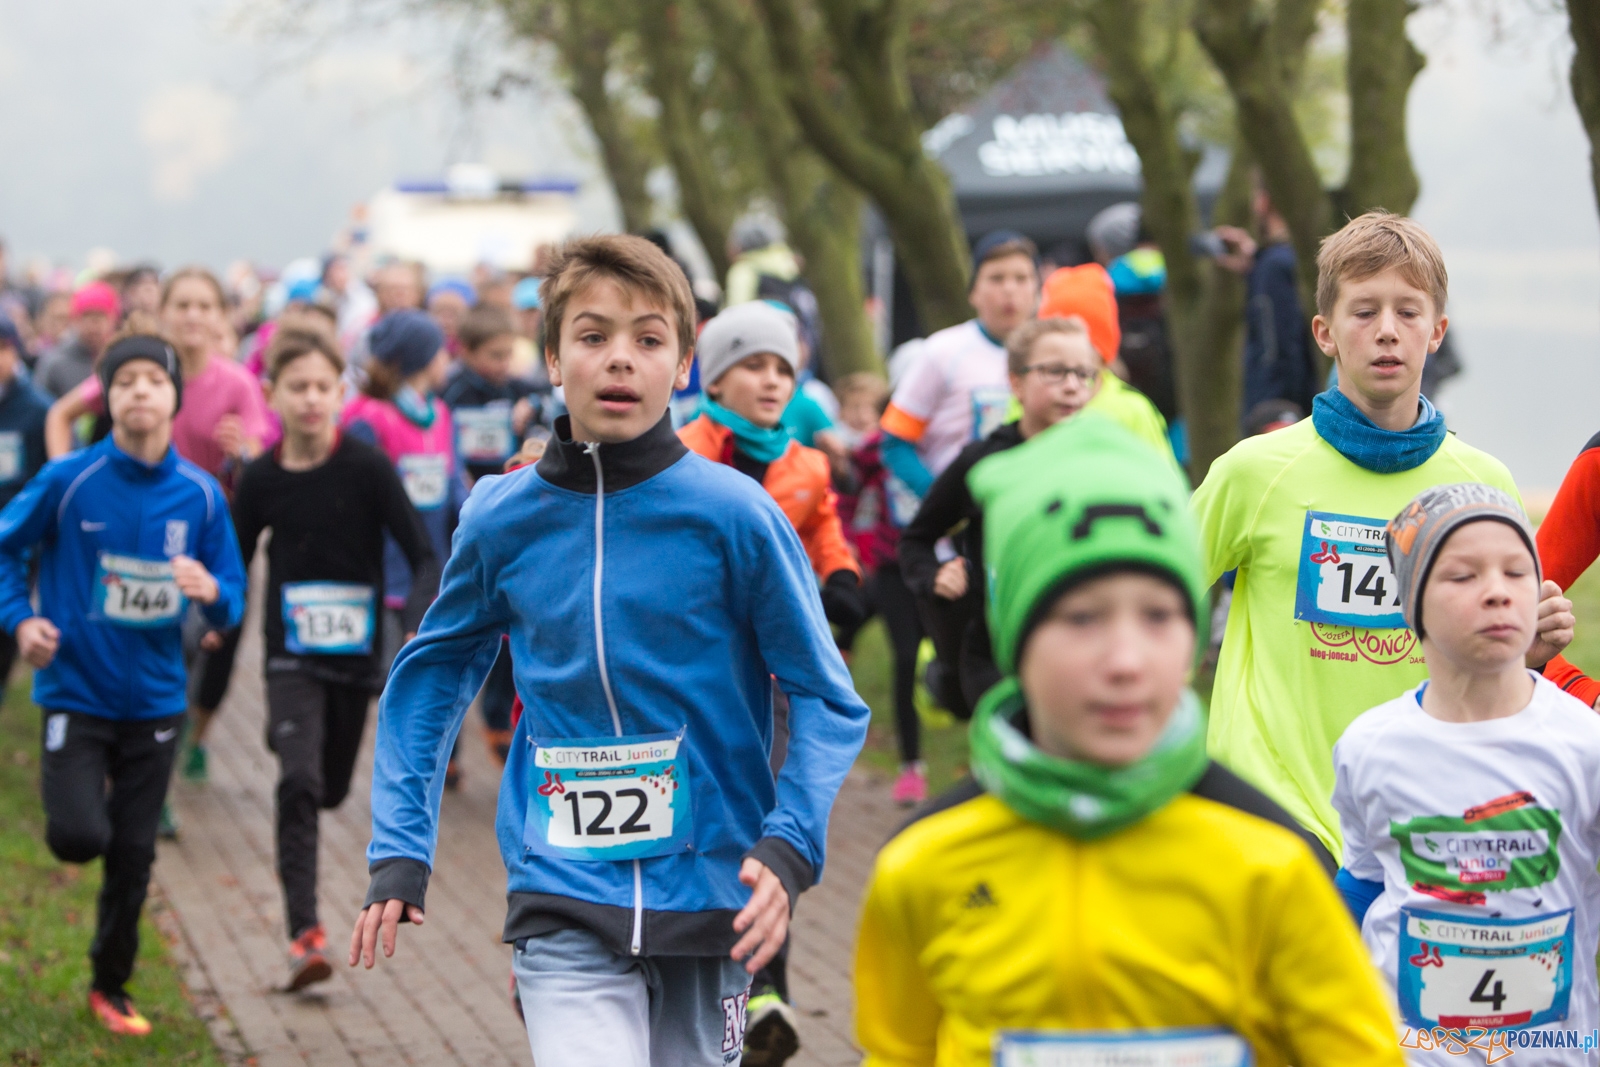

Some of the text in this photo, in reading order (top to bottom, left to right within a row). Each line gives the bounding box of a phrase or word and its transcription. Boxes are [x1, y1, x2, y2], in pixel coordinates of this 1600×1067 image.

[120, 584, 170, 613] 144
[1337, 562, 1402, 607] 14
[307, 610, 354, 637] 134
[627, 747, 669, 761] Junior
[564, 787, 652, 836] 122
[1519, 923, 1560, 941] Junior
[1469, 969, 1507, 1012] 4
